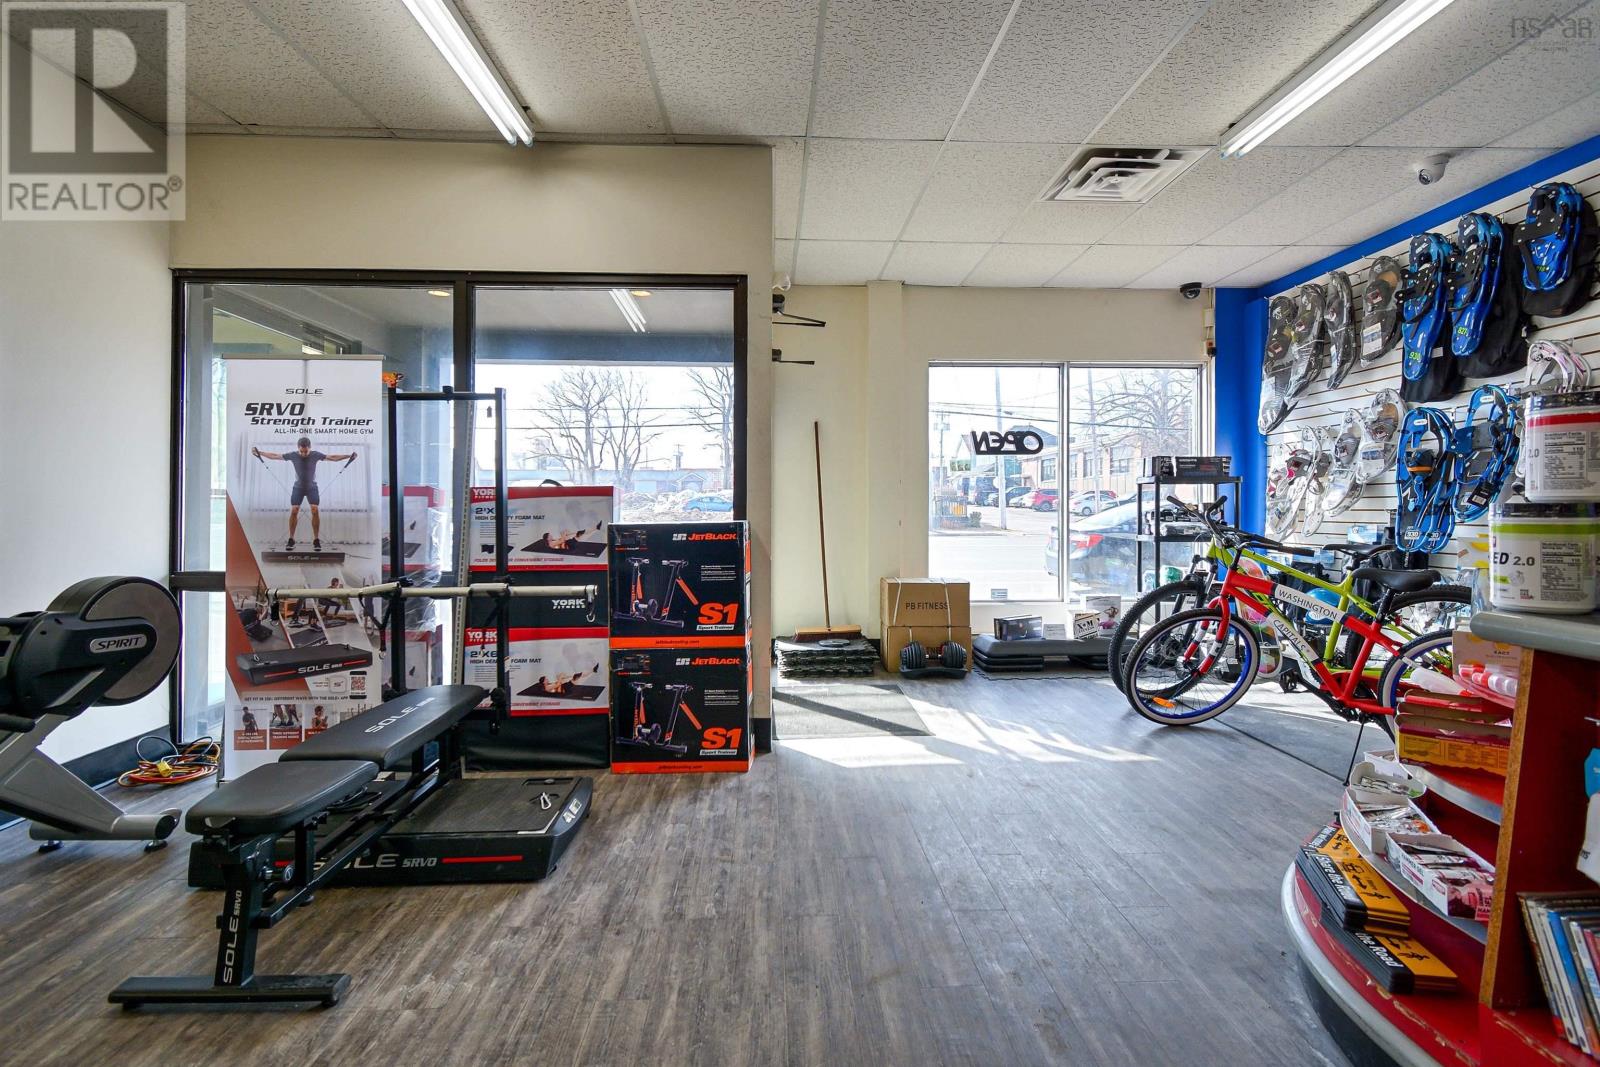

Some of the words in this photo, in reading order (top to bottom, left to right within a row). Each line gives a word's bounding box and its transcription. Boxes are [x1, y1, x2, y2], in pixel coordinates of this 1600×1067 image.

[244, 402, 306, 416] SRVO
[250, 416, 316, 428] Strength
[321, 416, 373, 426] Trainer
[475, 507, 496, 515] 2'X
[1513, 556, 1536, 567] 2.0
[697, 602, 739, 624] S1
[905, 602, 916, 610] PB
[917, 602, 949, 610] FITNESS
[1279, 589, 1338, 620] WASHINGTON
[95, 636, 142, 651] SPIRIT
[1273, 619, 1307, 651] CAPITALS
[297, 663, 331, 674] SOLE
[364, 706, 418, 733] SOLE
[702, 727, 742, 749] S1
[313, 853, 399, 871] SLE
[401, 857, 438, 868] SRVO
[223, 916, 239, 983] SOLE
[233, 890, 242, 916] SRVO
[1369, 945, 1404, 968] Road
